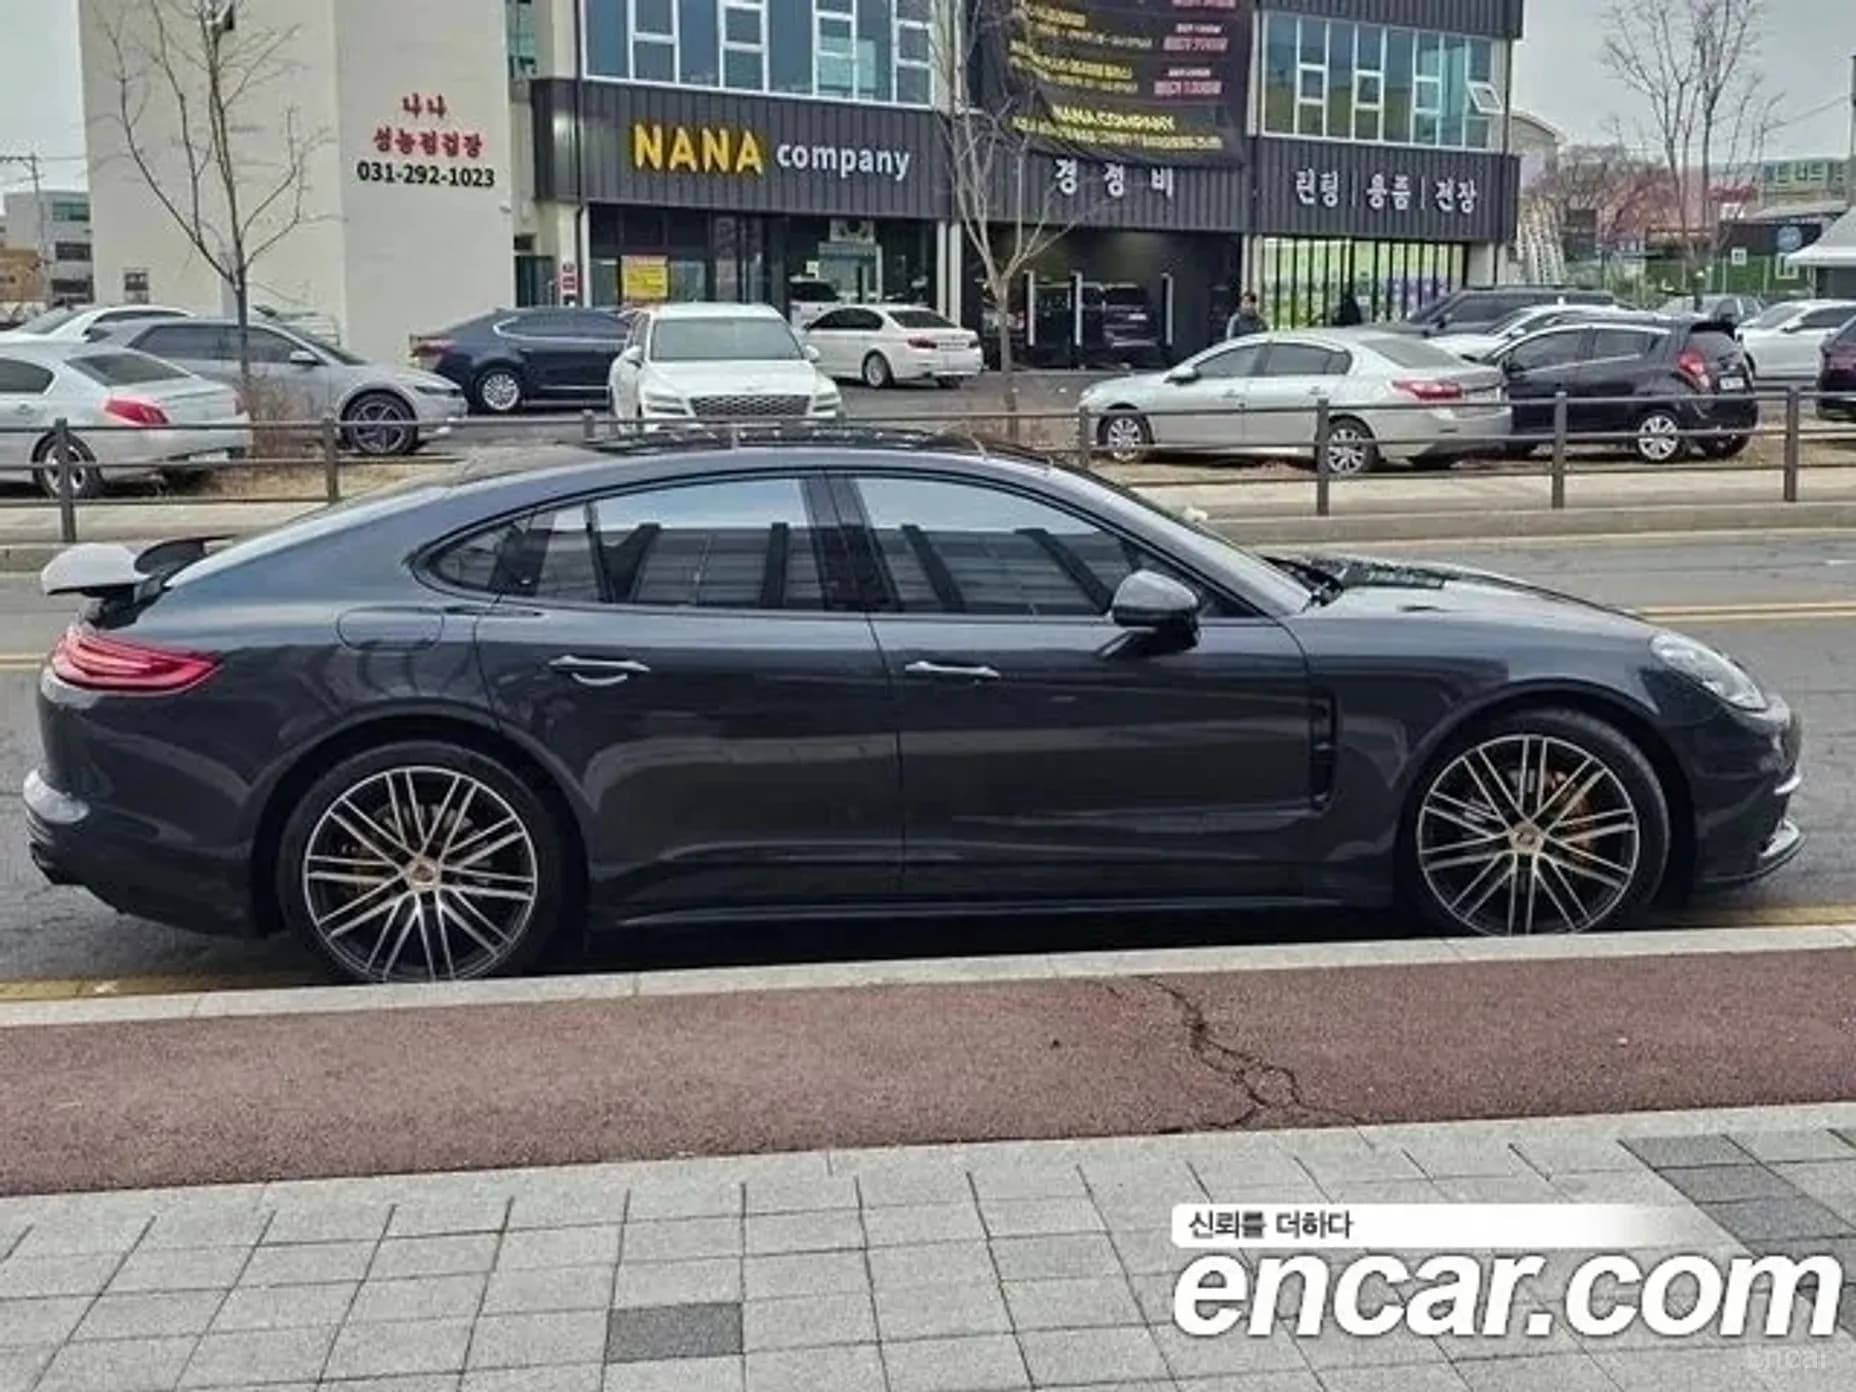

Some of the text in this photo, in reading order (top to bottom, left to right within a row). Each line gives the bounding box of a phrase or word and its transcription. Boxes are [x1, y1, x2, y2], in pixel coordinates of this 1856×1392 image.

[402, 92, 448, 119] 나나
[634, 124, 910, 181] NANA company
[357, 161, 495, 188] 031-292-1023
[1435, 178, 1477, 214] 전장
